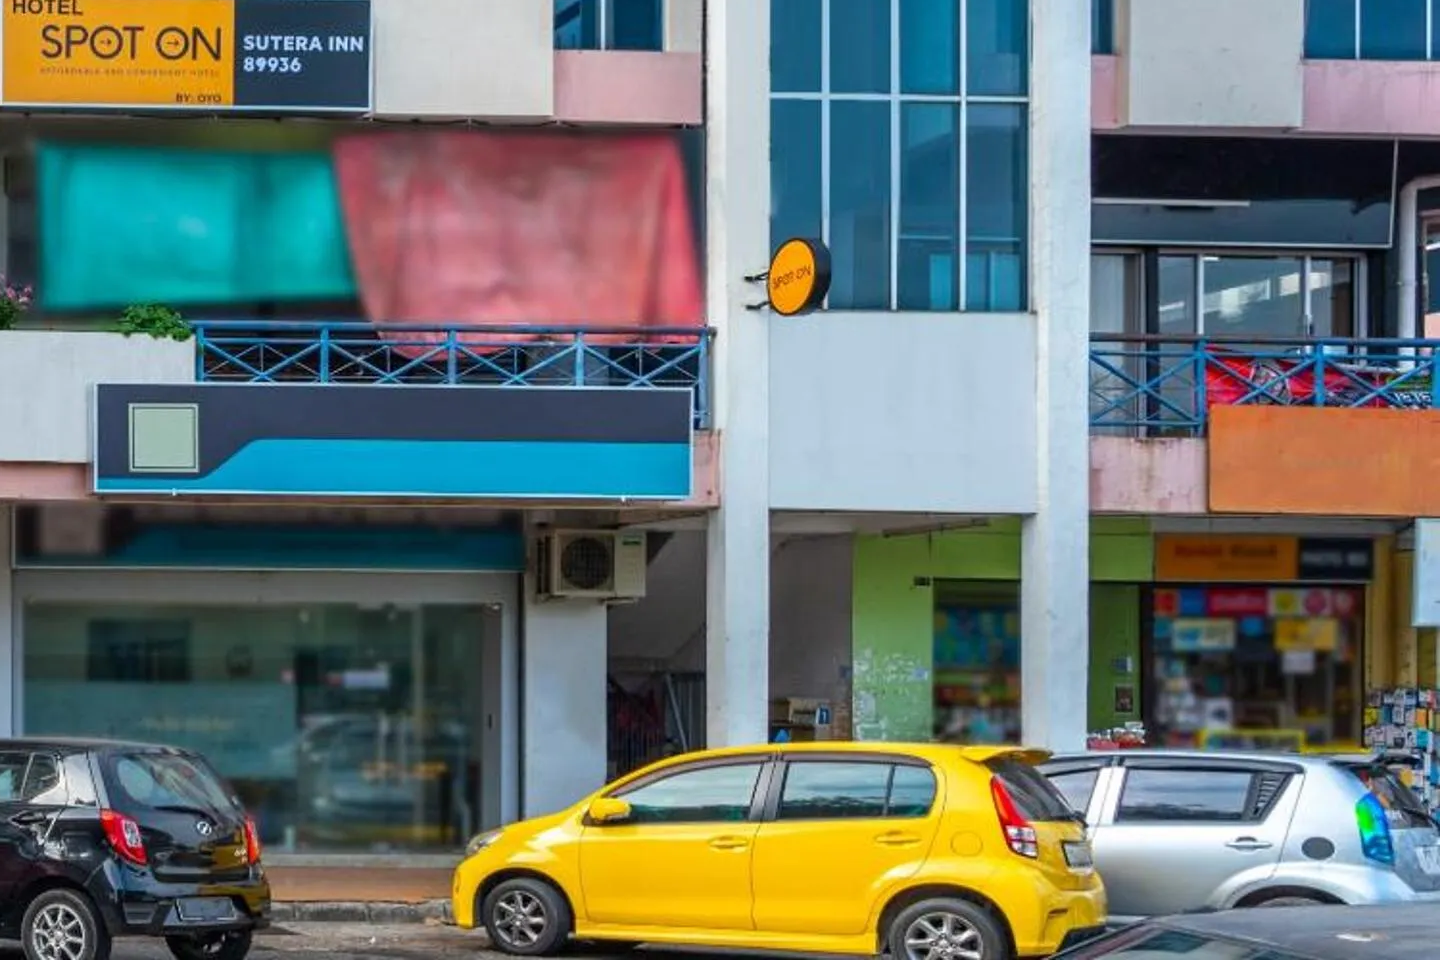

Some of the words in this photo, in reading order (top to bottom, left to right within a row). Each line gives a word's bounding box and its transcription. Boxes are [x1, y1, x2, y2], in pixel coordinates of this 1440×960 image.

[41, 24, 144, 60] SPOT
[155, 26, 222, 62] ON
[243, 35, 323, 52] SUTERA
[328, 36, 364, 53] INN
[243, 56, 302, 73] 89936
[196, 93, 222, 103] OYO
